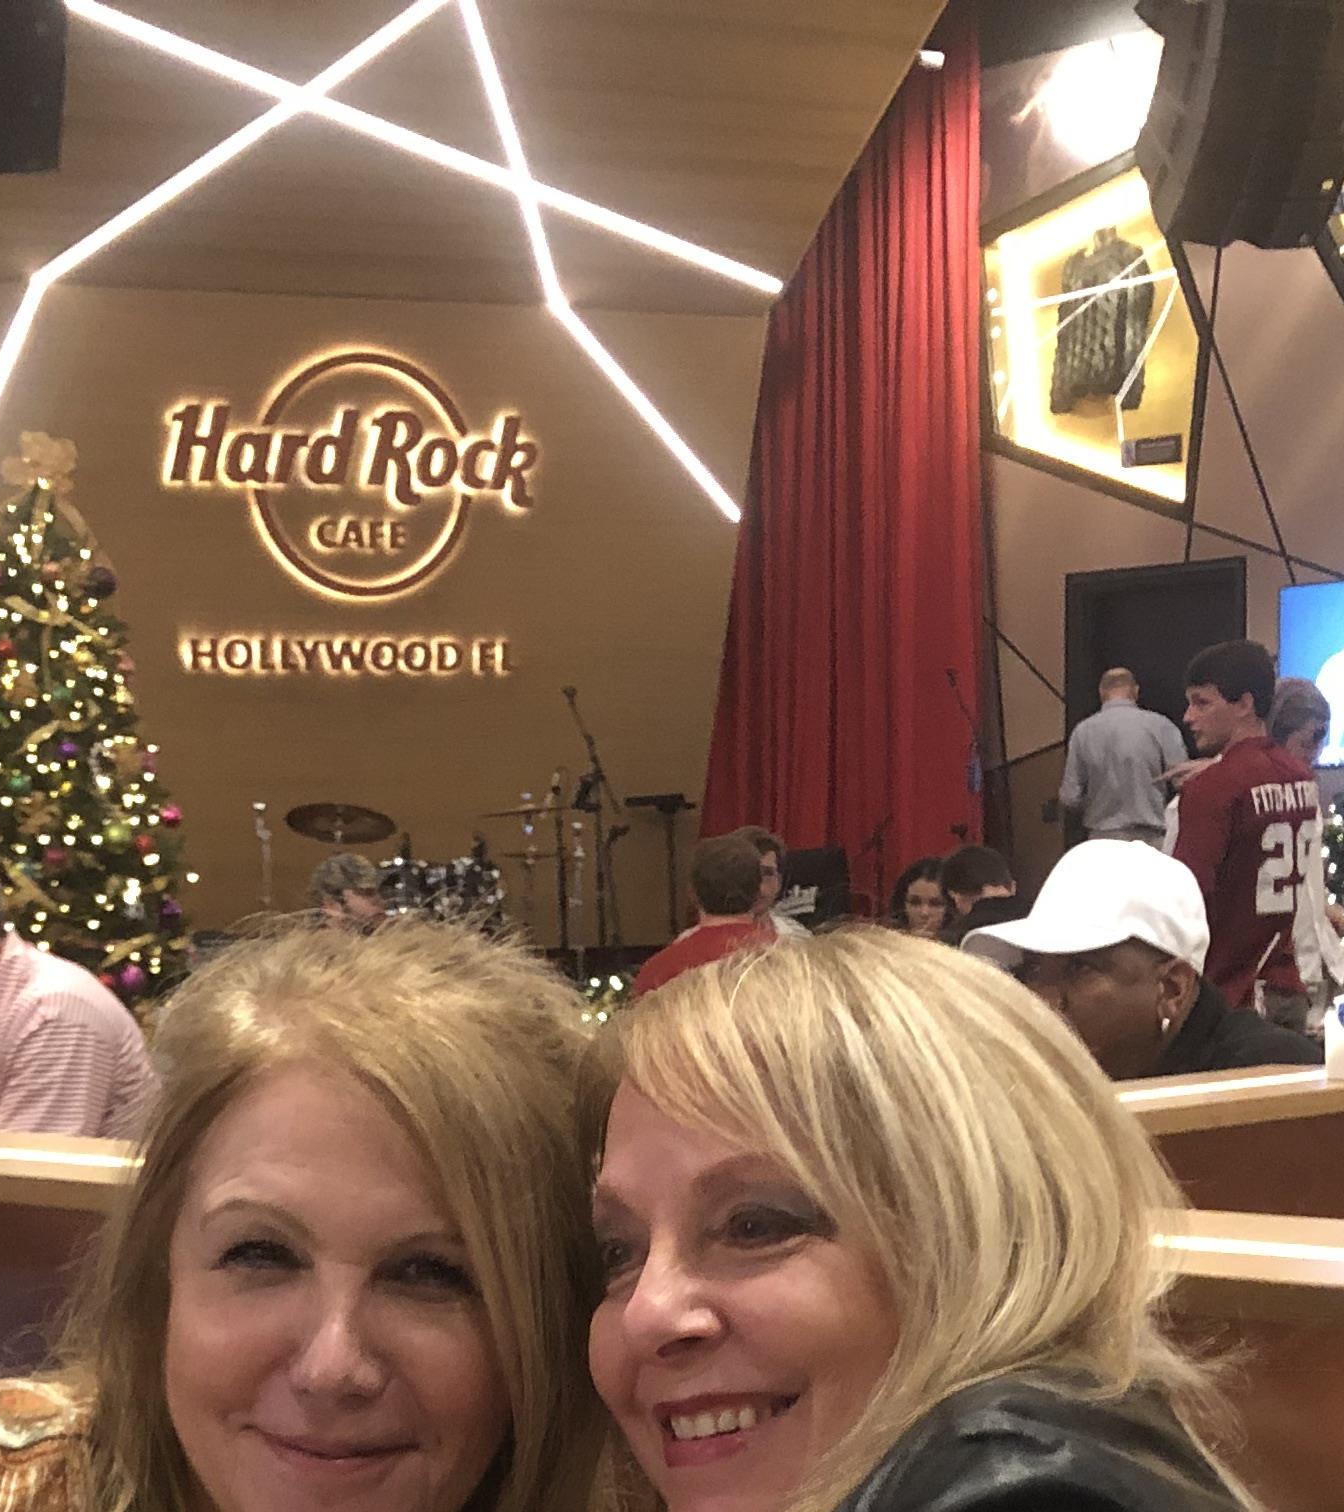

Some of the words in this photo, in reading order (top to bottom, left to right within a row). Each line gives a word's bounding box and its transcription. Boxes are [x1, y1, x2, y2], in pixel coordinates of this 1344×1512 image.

[169, 402, 356, 485] Hard
[366, 409, 538, 508] Rock
[315, 519, 408, 550] CAFE
[187, 637, 463, 673] HOLLYWOOD
[475, 638, 513, 674] FL
